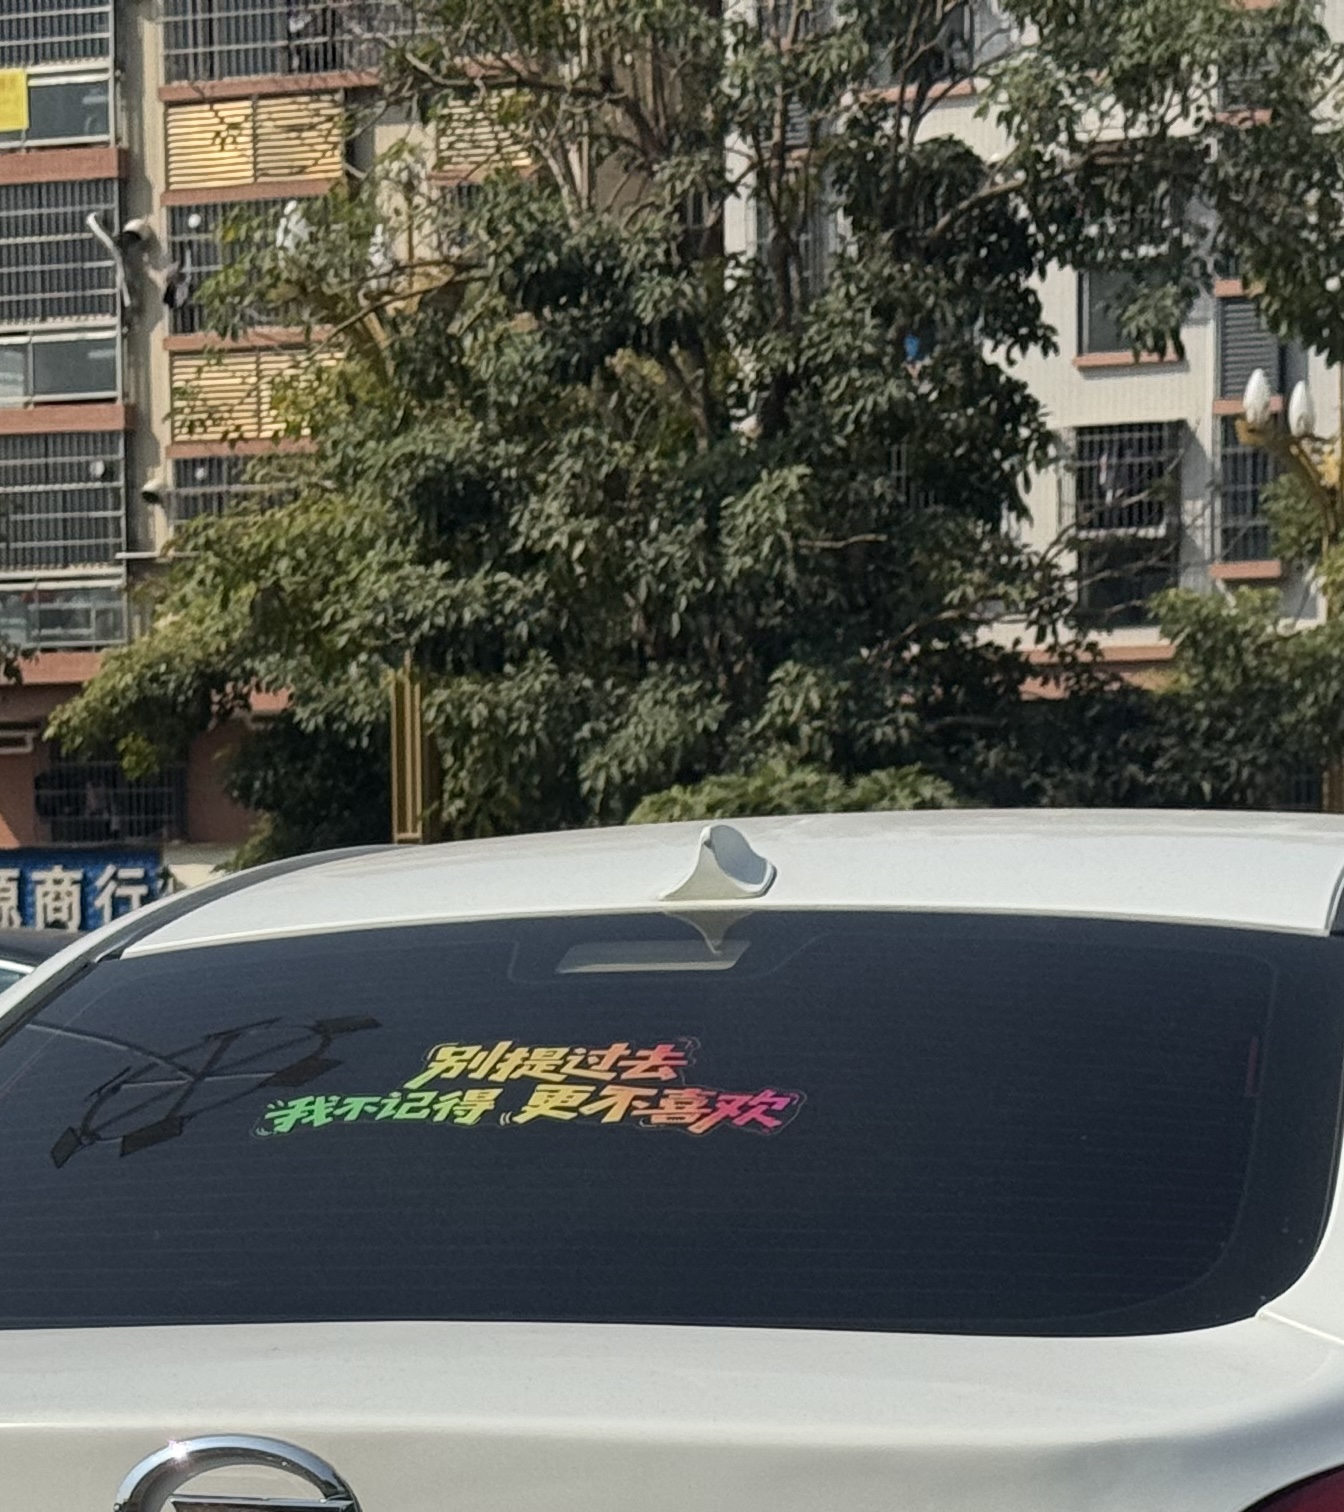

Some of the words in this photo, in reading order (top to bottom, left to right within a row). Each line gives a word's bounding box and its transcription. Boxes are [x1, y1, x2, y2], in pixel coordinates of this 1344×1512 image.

[405, 1040, 690, 1089] 别提过去
[265, 1087, 504, 1132] 我不记得
[513, 1084, 799, 1134] 更不喜欢
